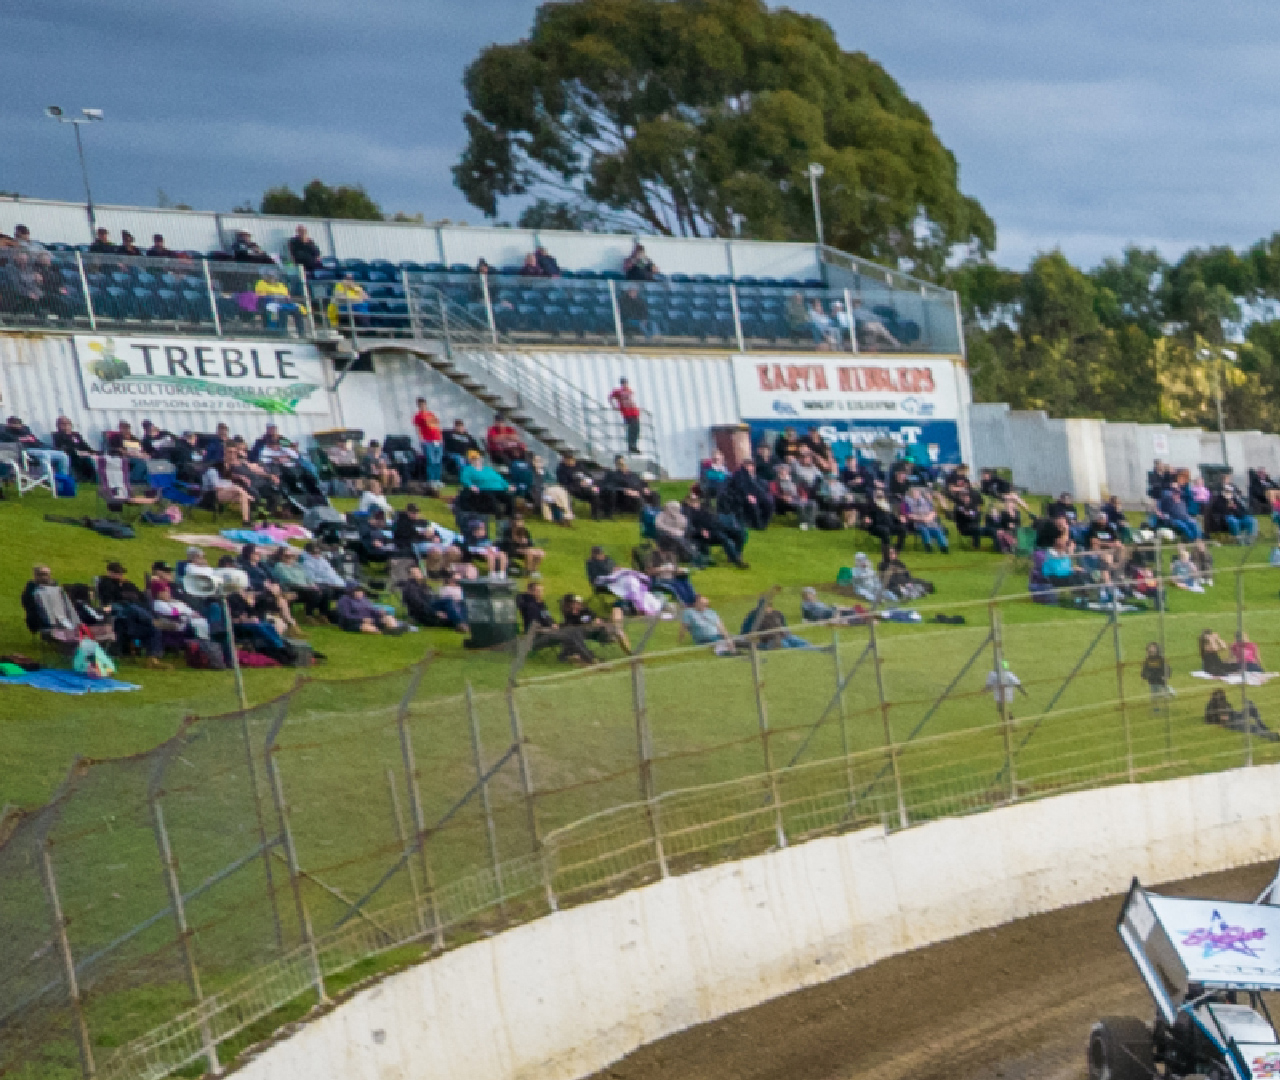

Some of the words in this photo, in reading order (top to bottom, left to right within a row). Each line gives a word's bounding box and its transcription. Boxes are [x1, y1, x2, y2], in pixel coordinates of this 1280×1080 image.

[130, 343, 299, 379] TREBLE
[90, 382, 200, 396] AGRICULTURAL
[131, 398, 190, 408] SIMPSON
